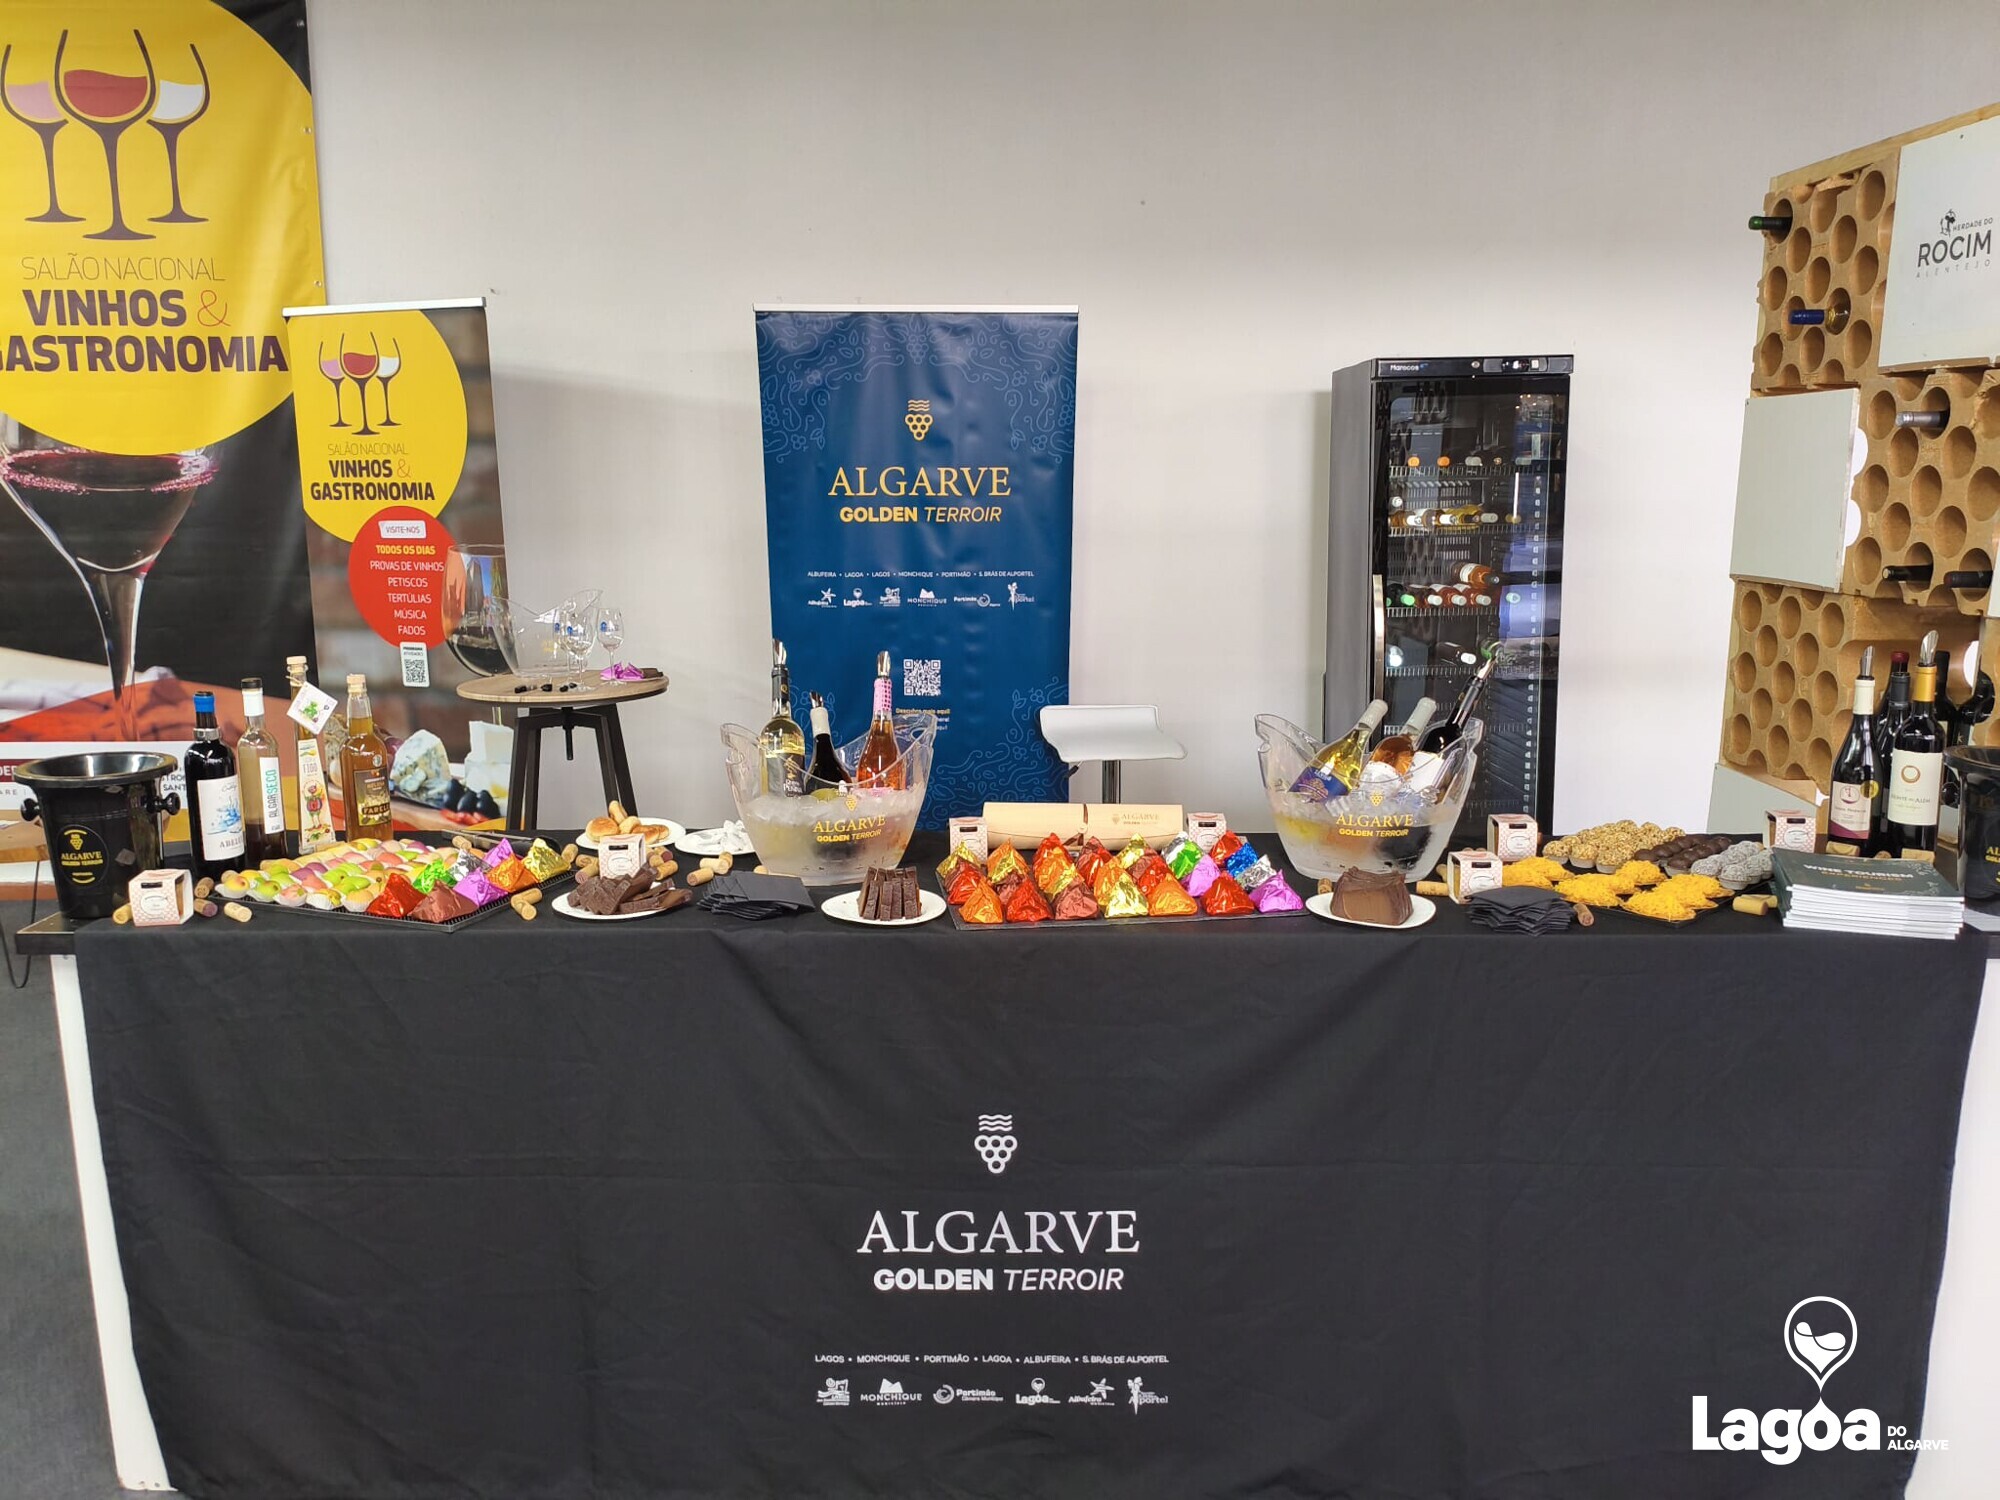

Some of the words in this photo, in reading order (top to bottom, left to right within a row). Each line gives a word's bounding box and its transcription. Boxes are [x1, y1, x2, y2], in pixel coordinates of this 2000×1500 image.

[1953, 220, 1982, 232] HERDADE
[1984, 217, 1994, 225] DO
[1917, 229, 1991, 268] ROCIM
[21, 253, 99, 281] SALÃO
[104, 257, 226, 282] NACIONAL
[1916, 259, 1991, 278] ALENTEJO
[22, 289, 187, 327] VINHOS
[197, 289, 231, 327] &
[0, 335, 289, 372] ASTRONOMIA
[327, 442, 359, 456] SALÃO
[359, 443, 409, 456] NACIONAL
[328, 459, 393, 478] VINHOS
[396, 458, 412, 479] &
[827, 466, 1012, 498] ALGARVE
[310, 482, 436, 501] GASTRONOMIA
[839, 506, 918, 523] GOLDEN
[923, 506, 1002, 523] TERROIR
[385, 526, 421, 534] VISITE-NOS
[375, 545, 402, 555] TODOS
[402, 545, 415, 555] OS
[416, 545, 436, 556] DIAS
[369, 560, 400, 571] PROVAS
[401, 561, 412, 571] DE
[413, 561, 445, 572] VINHOS
[941, 570, 971, 578] PORTIMÃO
[387, 577, 428, 588] PETISCOS
[387, 591, 432, 604] TERTÚLIAS
[843, 598, 865, 608] Lagoa
[393, 607, 427, 620] MÚSICA
[397, 625, 426, 636] FADOS
[265, 769, 278, 818] ALGARSECO
[812, 815, 886, 833] ALGARVE
[1336, 813, 1414, 828] ALGARVE
[816, 834, 850, 843] GOLDEN
[851, 829, 882, 840] TERROIR
[1339, 828, 1373, 836] GOLDEN
[1375, 828, 1409, 837] TERROIR
[61, 851, 103, 861] ALGARVE
[1803, 864, 1842, 873] WINE
[1844, 869, 1914, 878] TOURISM
[856, 1210, 1140, 1254] ALGARVE
[873, 1268, 994, 1291] GOLDEN
[1003, 1268, 1125, 1291] TERROIR
[814, 1354, 845, 1363] LAGOS
[856, 1354, 911, 1363] MONCHIQUE
[923, 1353, 970, 1363] PORTIMÃO
[982, 1355, 1012, 1363] LAGOA
[1023, 1355, 1071, 1364] ALBUFEIRA
[1082, 1355, 1090, 1363] S.
[1090, 1354, 1113, 1364] BRÁS
[1113, 1356, 1125, 1364] DE
[1126, 1355, 1169, 1363] ALPORTEL
[860, 1393, 923, 1402] MONCHIQUE
[956, 1388, 996, 1397] Portimão
[1015, 1394, 1049, 1406] Lagoa
